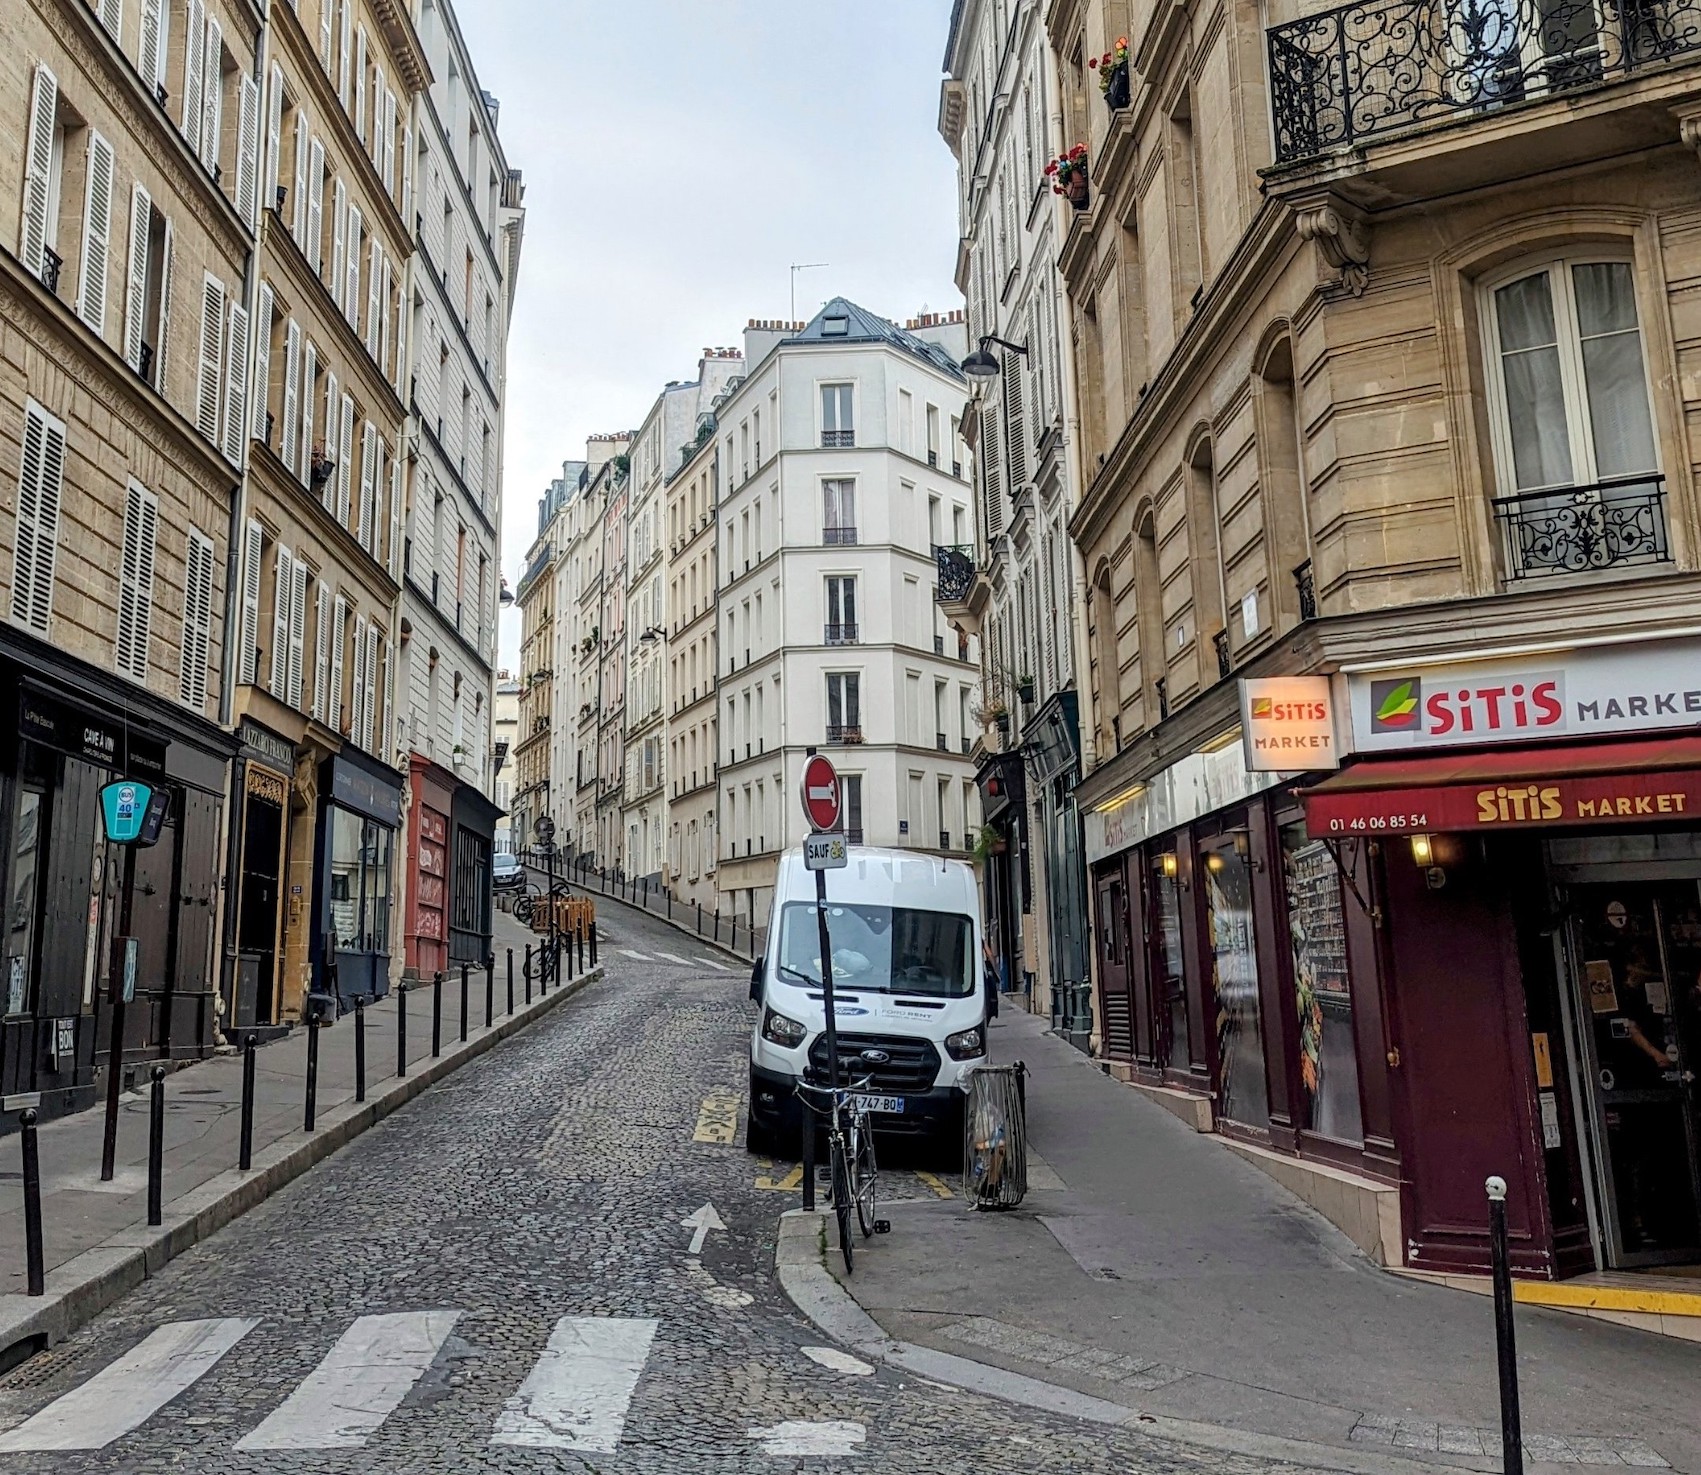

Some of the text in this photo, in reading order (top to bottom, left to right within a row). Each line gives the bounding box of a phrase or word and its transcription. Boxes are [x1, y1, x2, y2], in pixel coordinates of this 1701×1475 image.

[84, 728, 99, 747] CAVE
[105, 736, 114, 752] VIN
[1255, 736, 1329, 749] MARKET
[119, 804, 132, 812] 40
[1577, 794, 1686, 817] MARKET
[1330, 814, 1427, 831] 01 46 06 85 54
[809, 843, 829, 859] SAUF
[59, 1030, 74, 1049] BON
